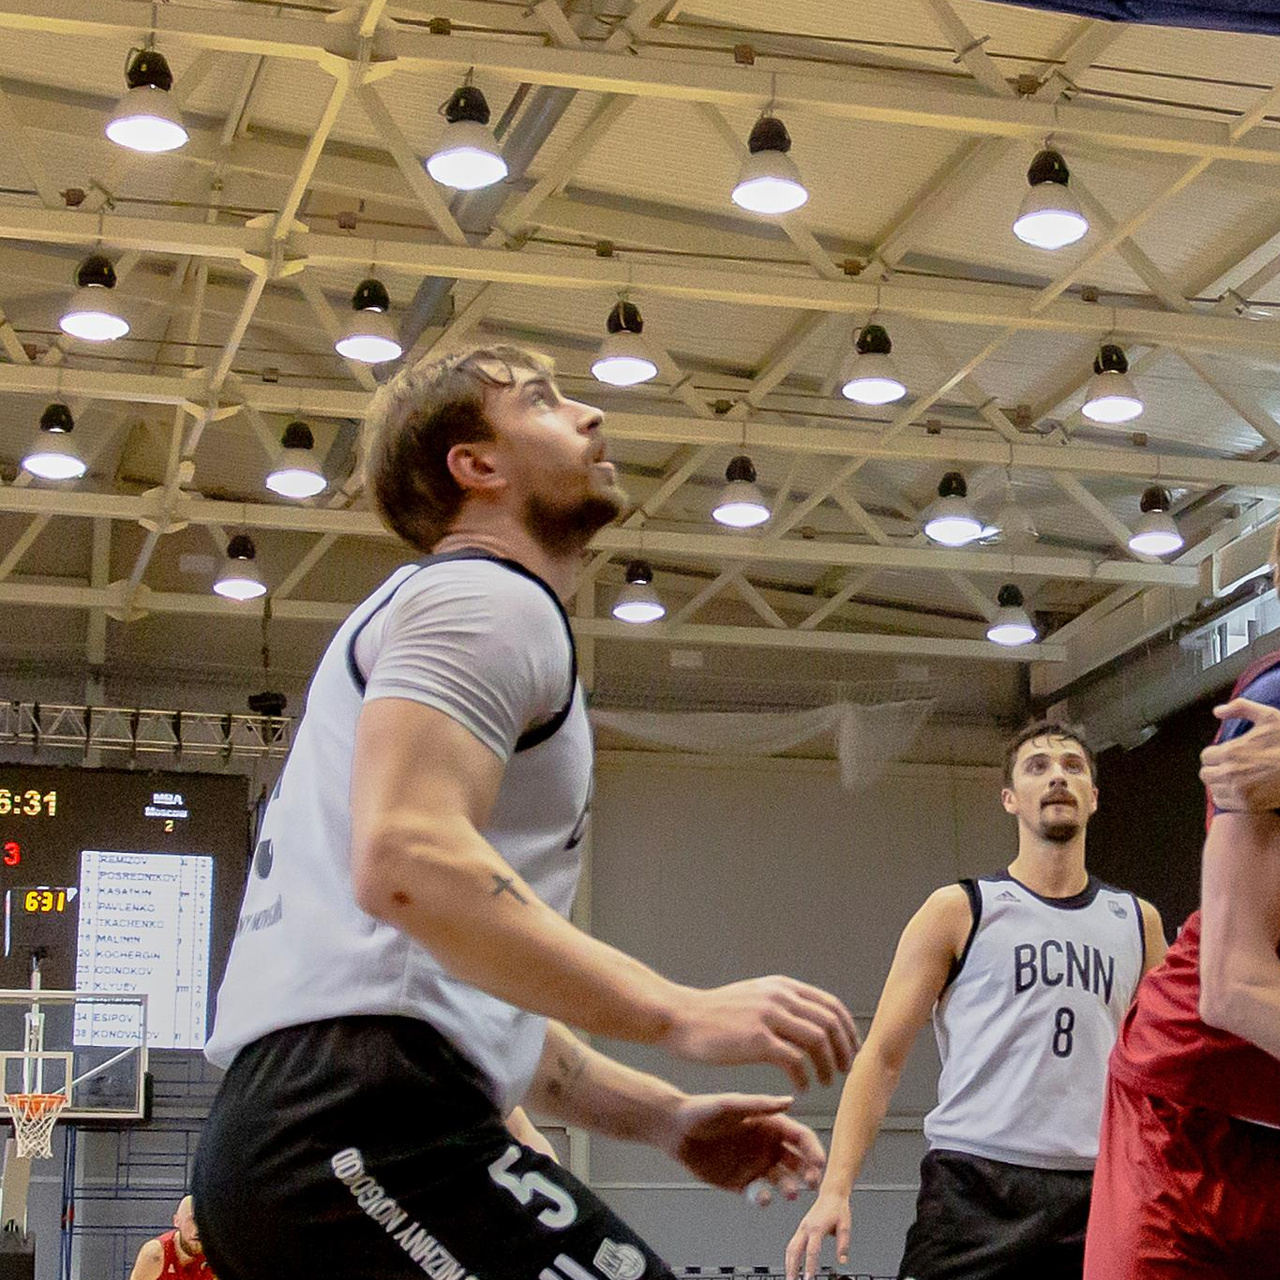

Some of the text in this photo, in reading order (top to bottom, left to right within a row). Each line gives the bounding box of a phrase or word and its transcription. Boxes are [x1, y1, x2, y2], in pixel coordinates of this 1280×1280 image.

[0, 789, 57, 817] 6:31
[165, 819, 174, 833] 2
[4, 841, 21, 866] 3
[1014, 939, 1115, 1005] BCNN
[94, 1013, 133, 1023] ESIPOV
[1052, 1006, 1076, 1059] 8
[488, 1144, 579, 1231] 5
